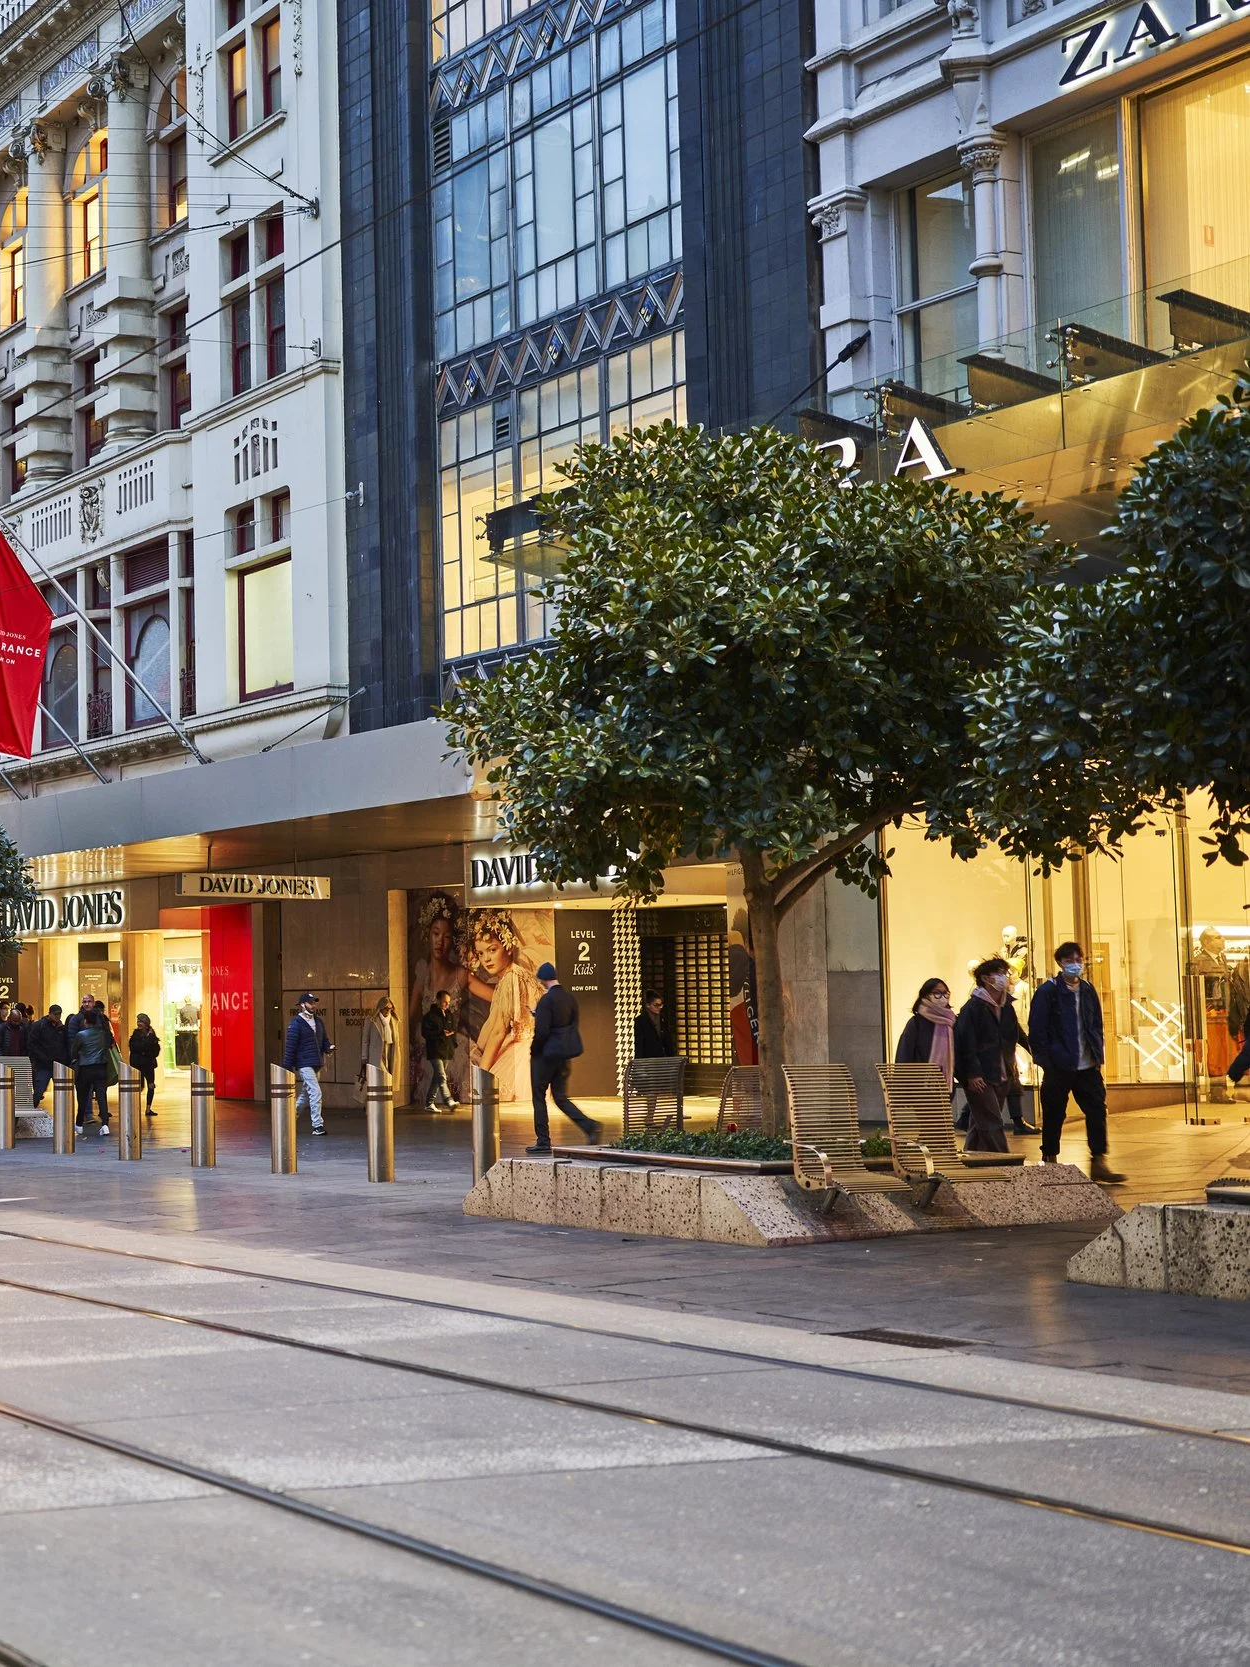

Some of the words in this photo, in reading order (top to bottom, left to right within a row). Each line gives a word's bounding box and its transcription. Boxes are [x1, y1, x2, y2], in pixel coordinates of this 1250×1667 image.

[6, 631, 27, 640] JONES
[200, 876, 253, 894] DAVID
[256, 879, 315, 896] JONES
[58, 890, 123, 929] JONES
[570, 930, 596, 939] LEVEL
[578, 941, 590, 962] 2
[0, 985, 10, 999] 2
